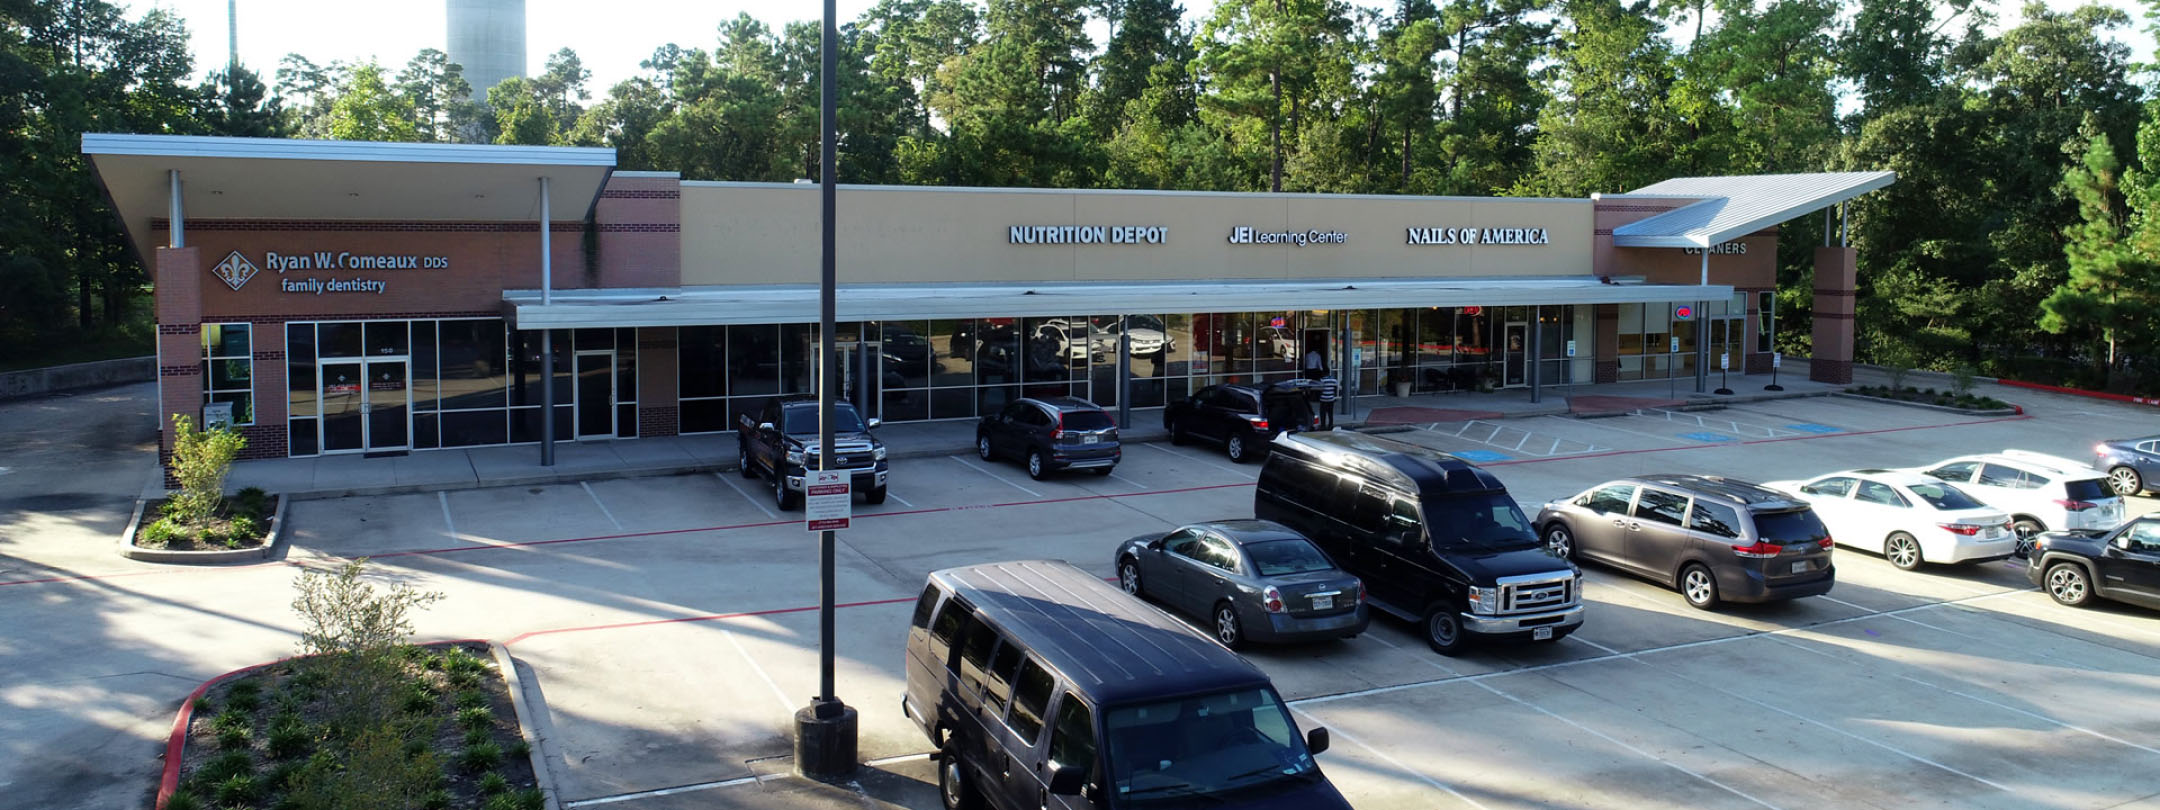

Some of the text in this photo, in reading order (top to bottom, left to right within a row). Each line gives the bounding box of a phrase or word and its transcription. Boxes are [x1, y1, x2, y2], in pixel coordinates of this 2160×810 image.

[1009, 226, 1168, 244] NUTRITION DEPOT
[1228, 226, 1348, 247] JEI Learning Center
[1407, 228, 1549, 244] NAILS OF AMERICA
[266, 252, 448, 273] Ryan W. Comeaux DDS
[281, 277, 386, 295] family dentistry
